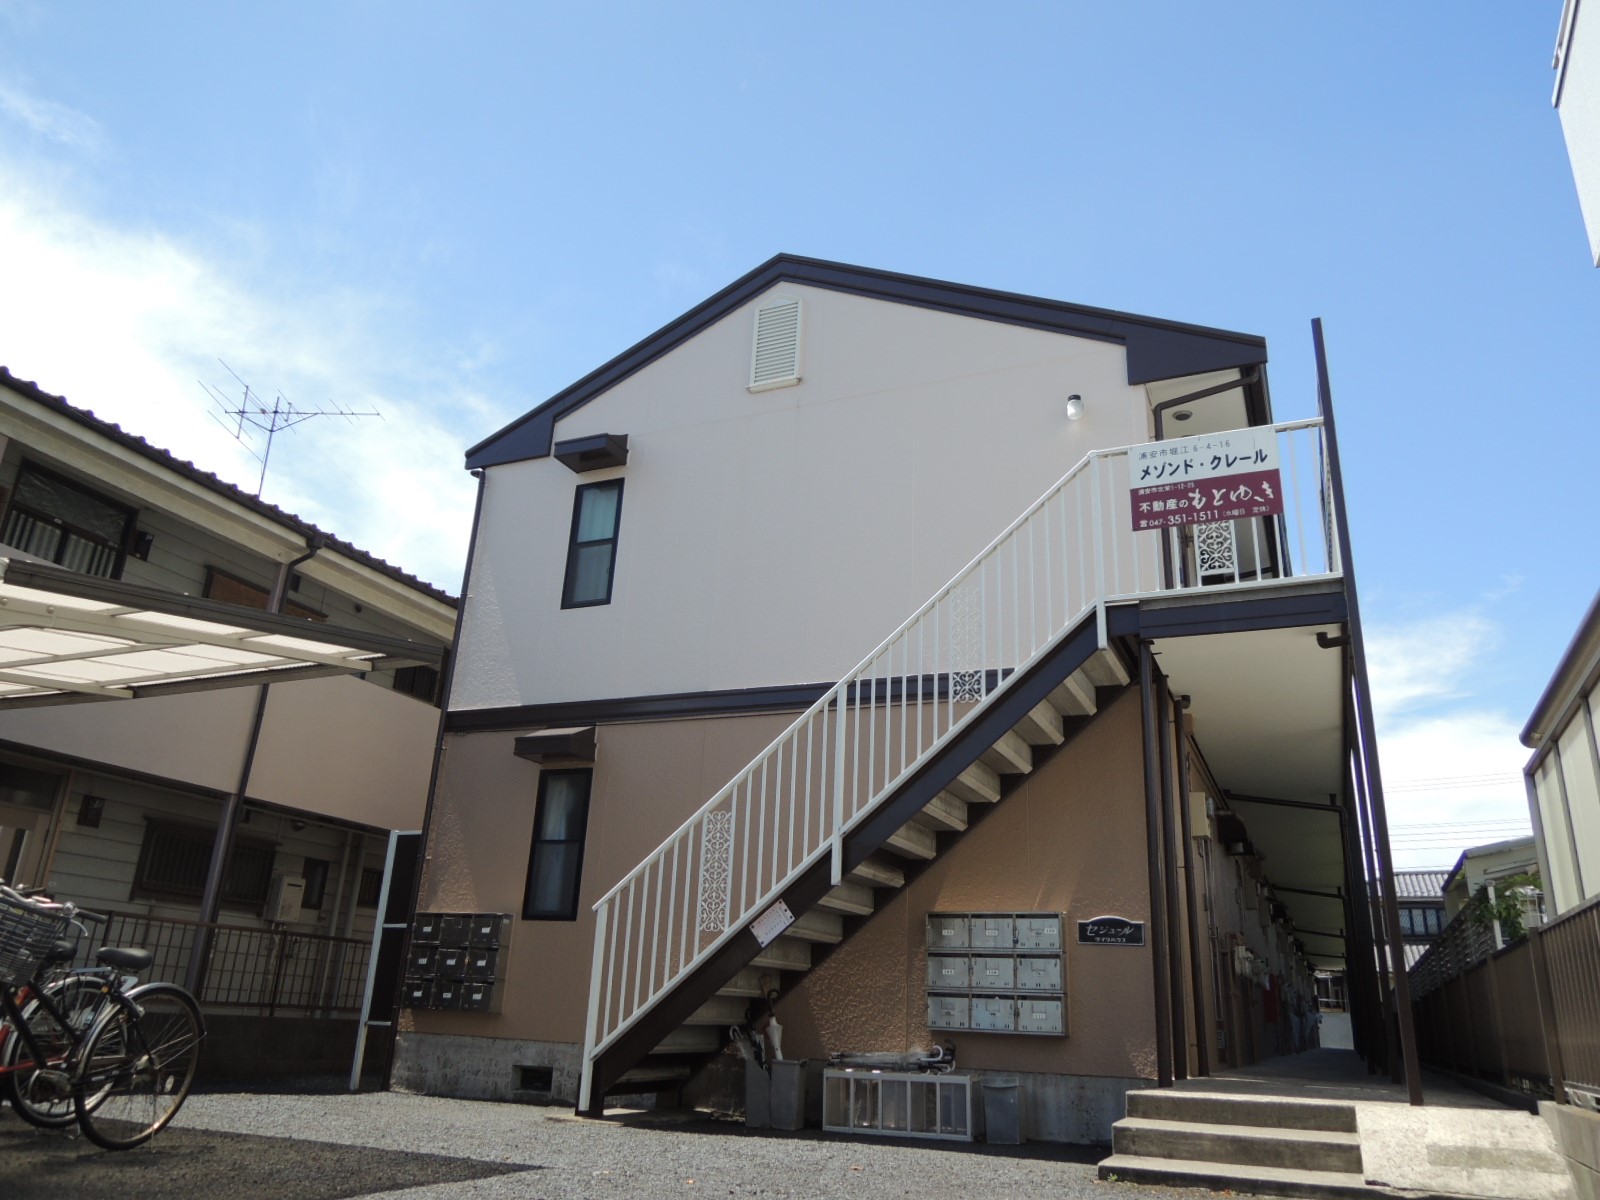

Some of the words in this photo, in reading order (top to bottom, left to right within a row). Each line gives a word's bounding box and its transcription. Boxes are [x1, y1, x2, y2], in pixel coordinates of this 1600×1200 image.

[1140, 448, 1268, 481] メゾンド・クレール
[1138, 480, 1275, 514] 不動産のもとゆき
